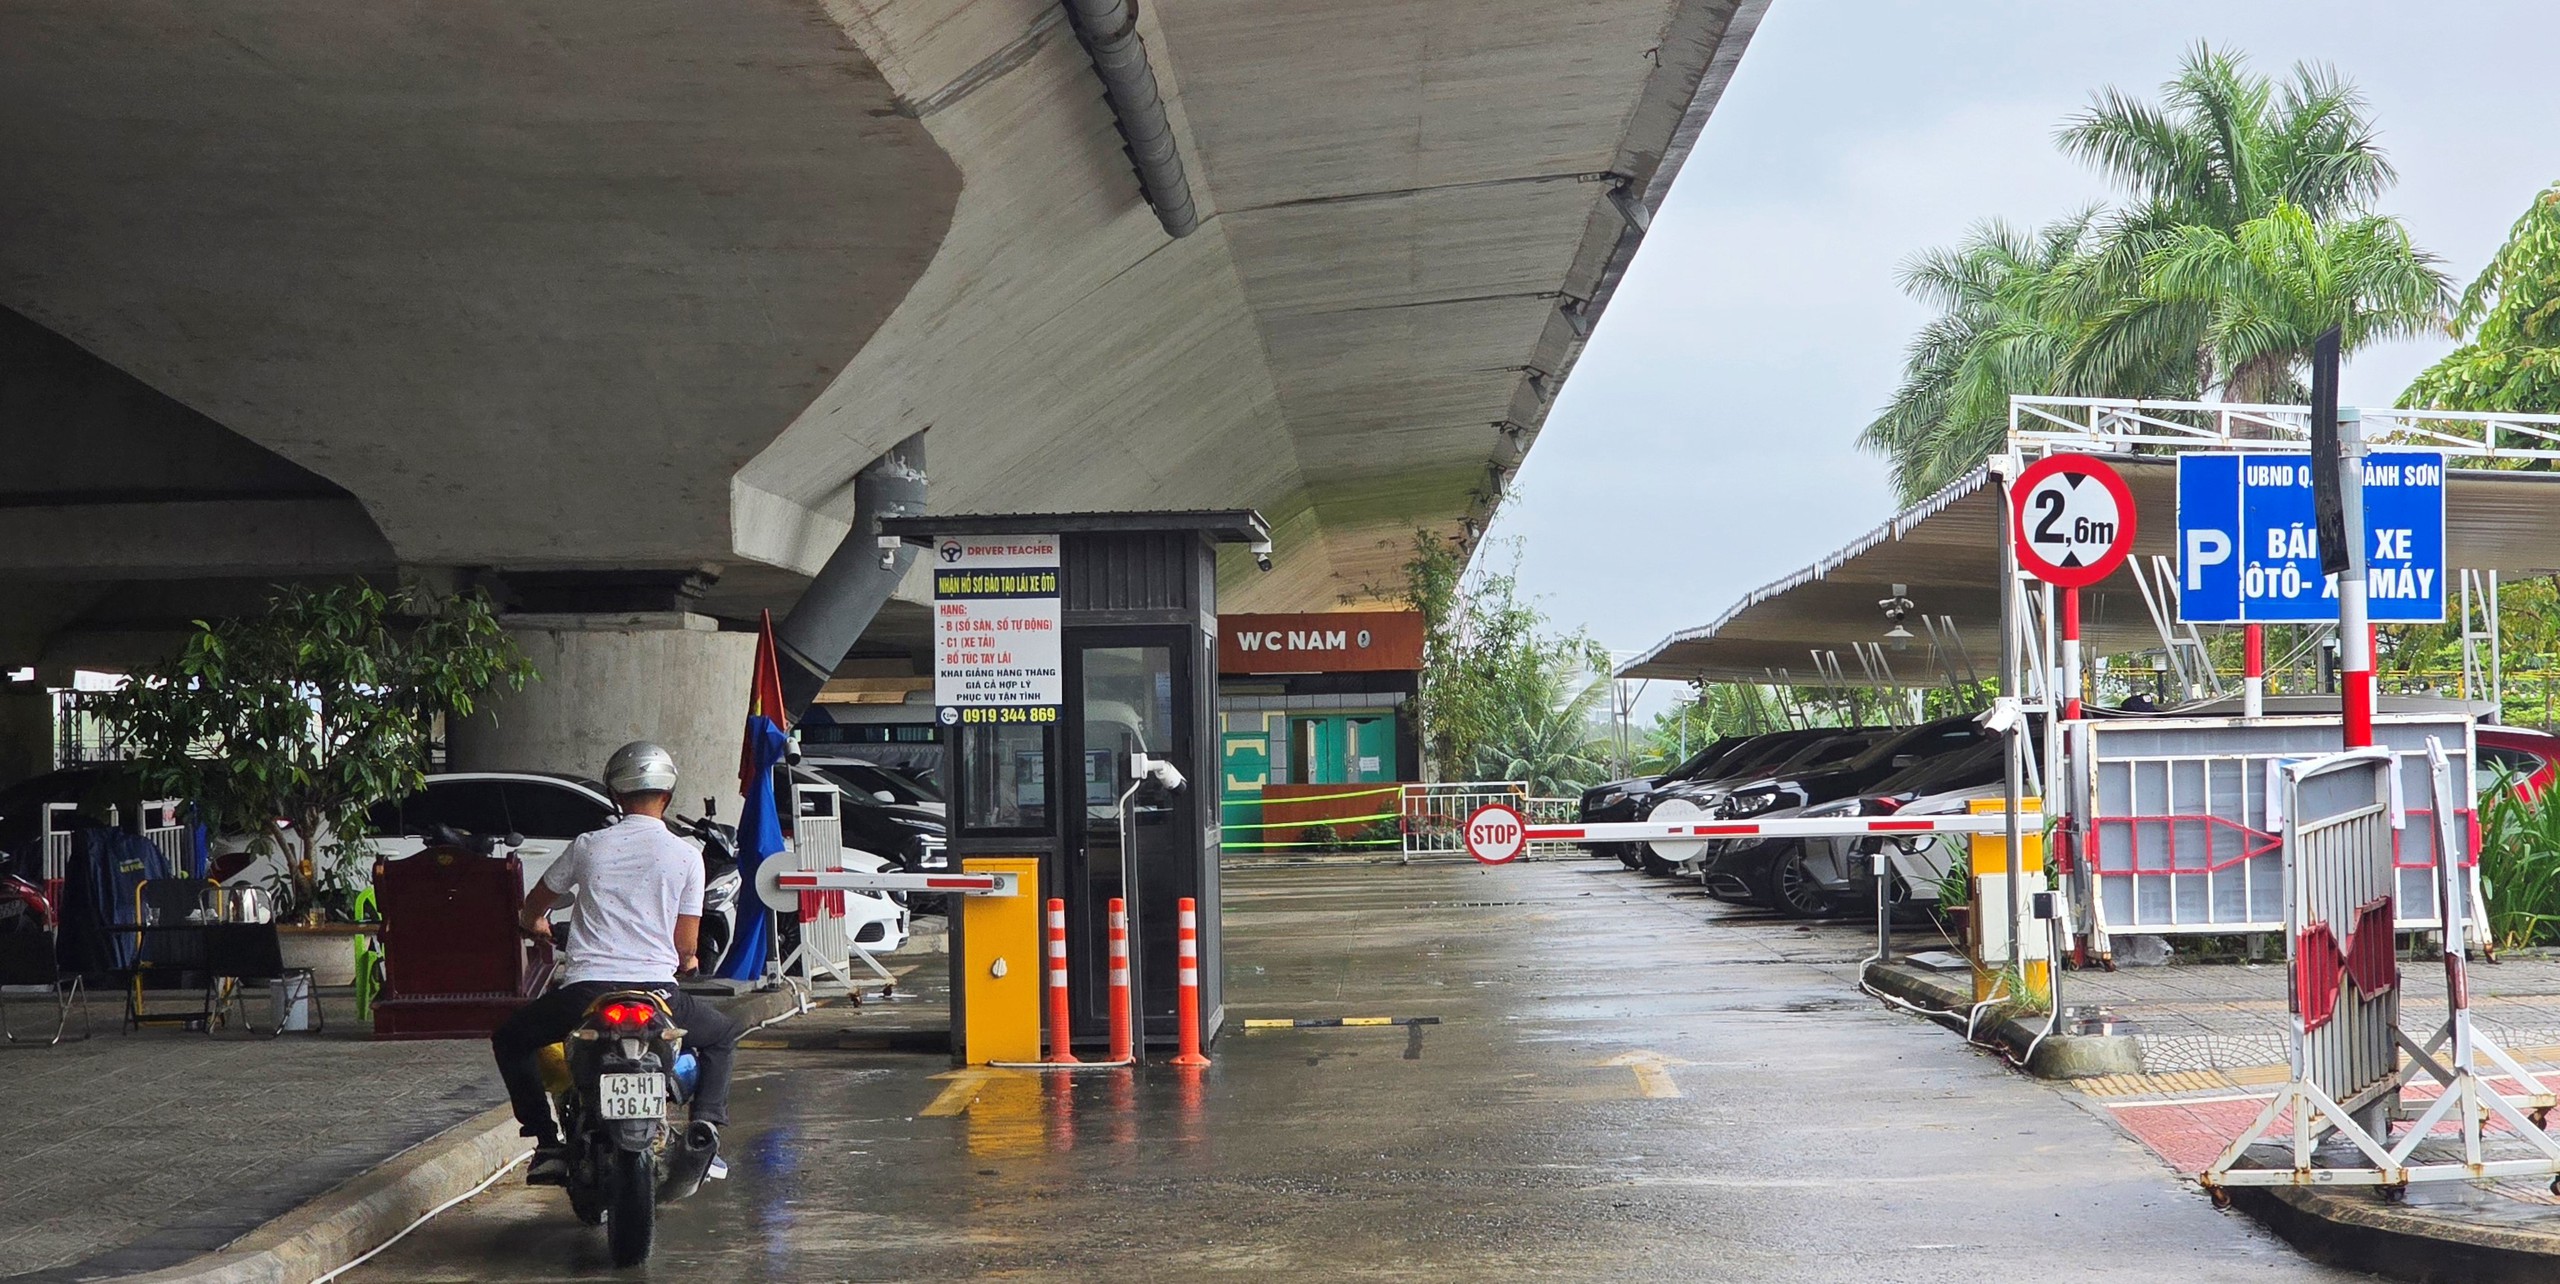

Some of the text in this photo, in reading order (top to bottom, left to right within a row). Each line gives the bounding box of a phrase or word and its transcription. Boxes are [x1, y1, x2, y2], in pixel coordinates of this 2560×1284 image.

[2247, 465, 2293, 487] UBND
[2404, 463, 2440, 487] SƠN
[2034, 489, 2114, 548] 2,6m
[967, 545, 1053, 556] DRIVER TEACHER
[2268, 522, 2413, 560] BÃI XE
[2187, 529, 2231, 591] P
[939, 573, 960, 597] NHẬN
[972, 575, 983, 593] SƠ
[984, 573, 1000, 593] ĐÀO
[1001, 575, 1015, 597] TẠO
[1016, 572, 1028, 592] LÁI
[1030, 575, 1040, 592] XE
[1041, 571, 1056, 592] ÔTÔ
[2245, 560, 2313, 599] ÔTÔ-
[2369, 562, 2435, 599] MÁY
[946, 621, 953, 631] B
[955, 617, 970, 632] (SỐ
[996, 616, 1009, 631] SỐ
[1011, 620, 1024, 633] TỰ
[1024, 617, 1053, 632] ĐỘNG)
[947, 637, 957, 648] C1
[961, 637, 975, 648] (XE
[978, 633, 995, 648] TẢI)
[1236, 630, 1346, 651] WC NAM
[947, 650, 959, 664] BỔ
[961, 651, 978, 664] TÚC
[981, 653, 995, 664] TAY
[997, 651, 1012, 664] LÁI
[941, 667, 1056, 678] KHAI GIẢNG HÀNG THÁNG
[966, 679, 1031, 690] GIÁ CẢ HỢP LÝ
[956, 692, 1041, 702] PHỤC VỤ TẬN TÌNH
[962, 708, 997, 723] 0919
[1000, 708, 1026, 722] 344
[1029, 707, 1056, 722] 869
[1473, 824, 1518, 845] STOP
[611, 1077, 654, 1096] 43-H1
[607, 1096, 663, 1117] 136.47
